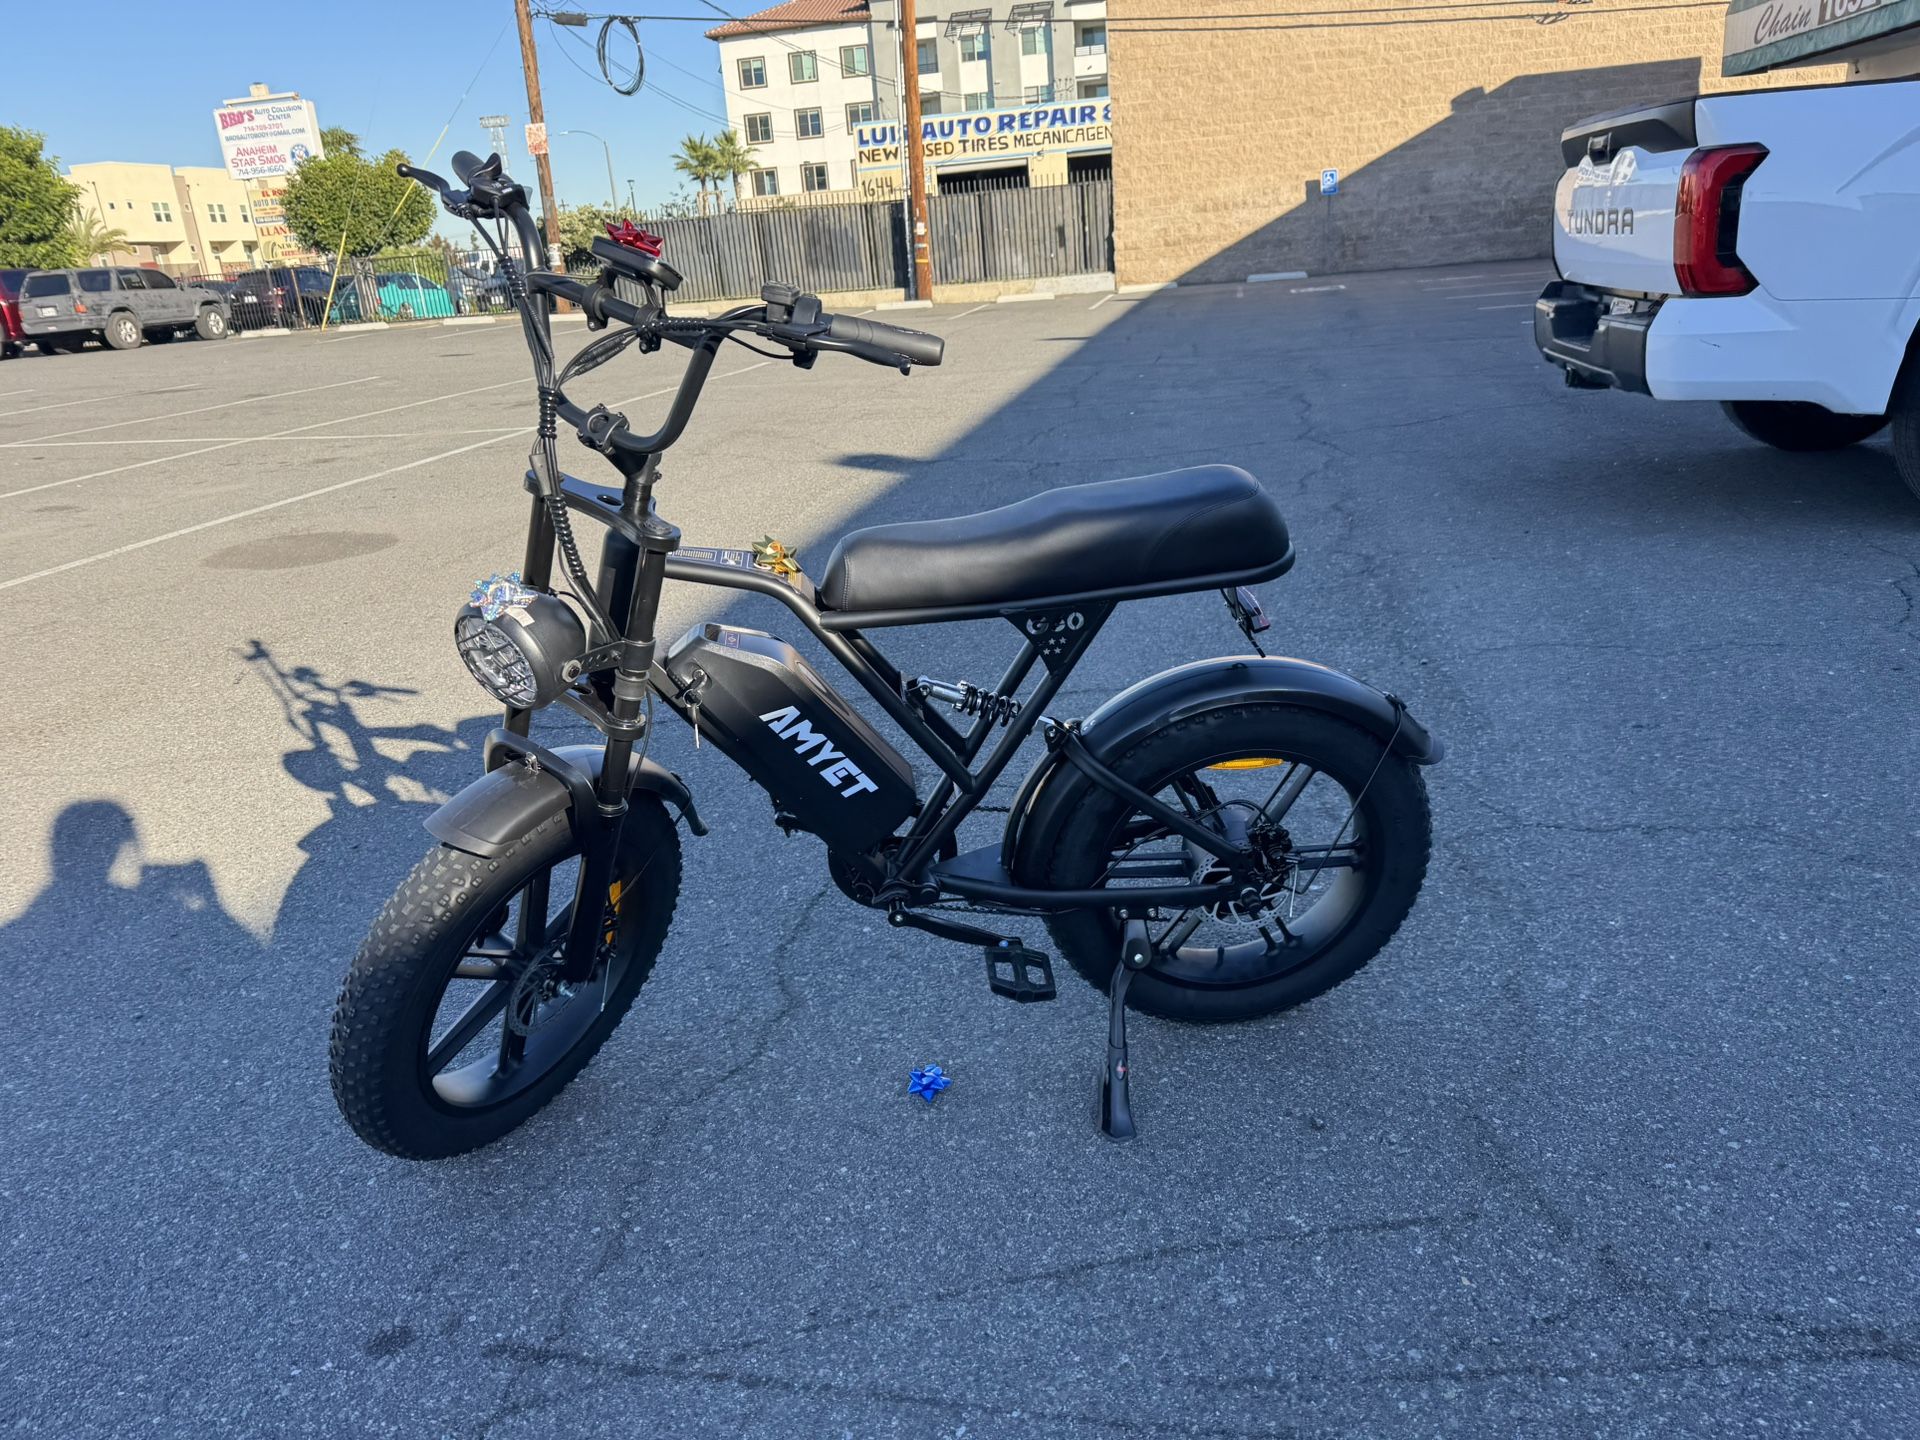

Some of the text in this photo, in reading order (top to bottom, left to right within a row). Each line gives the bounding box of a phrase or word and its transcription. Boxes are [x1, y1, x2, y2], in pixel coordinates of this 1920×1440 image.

[1754, 4, 1811, 45] Chain
[218, 110, 255, 130] BRO'S
[271, 104, 302, 113] COLLISION
[267, 113, 291, 121] CENTER
[921, 116, 991, 139] AUTO
[998, 105, 1097, 133] REPAIR
[231, 154, 287, 168] STAR SMOG
[236, 145, 277, 157] ANAHEIM
[858, 147, 899, 163] NEW
[958, 136, 1009, 153] TIRES
[237, 165, 284, 176] 714-956-1660
[861, 175, 893, 198] 1644
[1567, 207, 1634, 235] TUNDRA
[758, 705, 879, 798] AMYET
